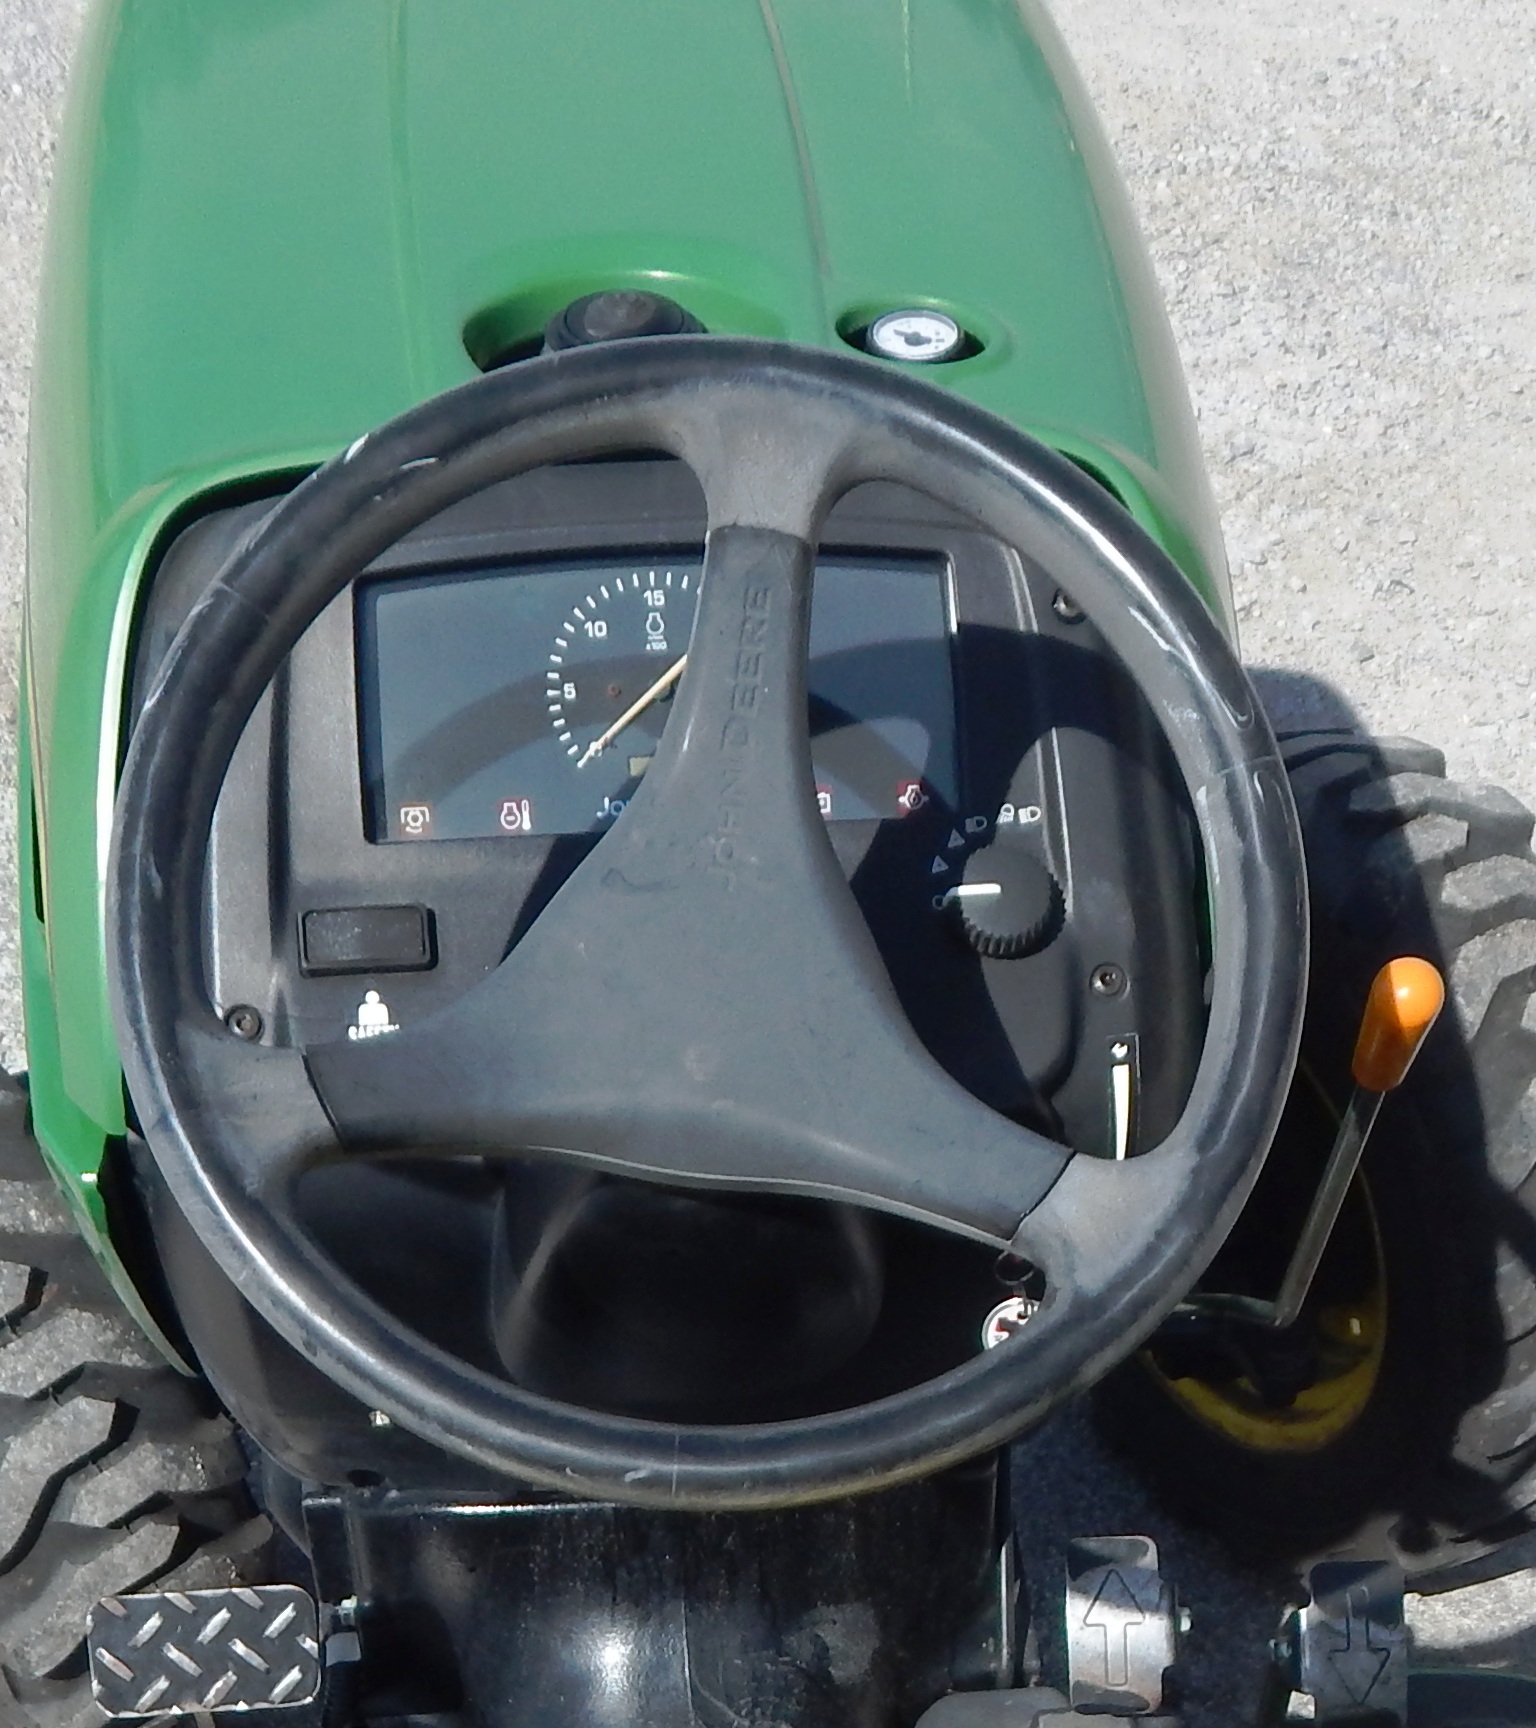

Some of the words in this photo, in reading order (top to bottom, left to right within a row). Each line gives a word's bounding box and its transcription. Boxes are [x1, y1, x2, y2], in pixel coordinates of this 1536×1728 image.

[644, 589, 665, 607] 15
[584, 620, 607, 638] 10
[720, 587, 770, 750] DEERE
[563, 682, 576, 699] 5
